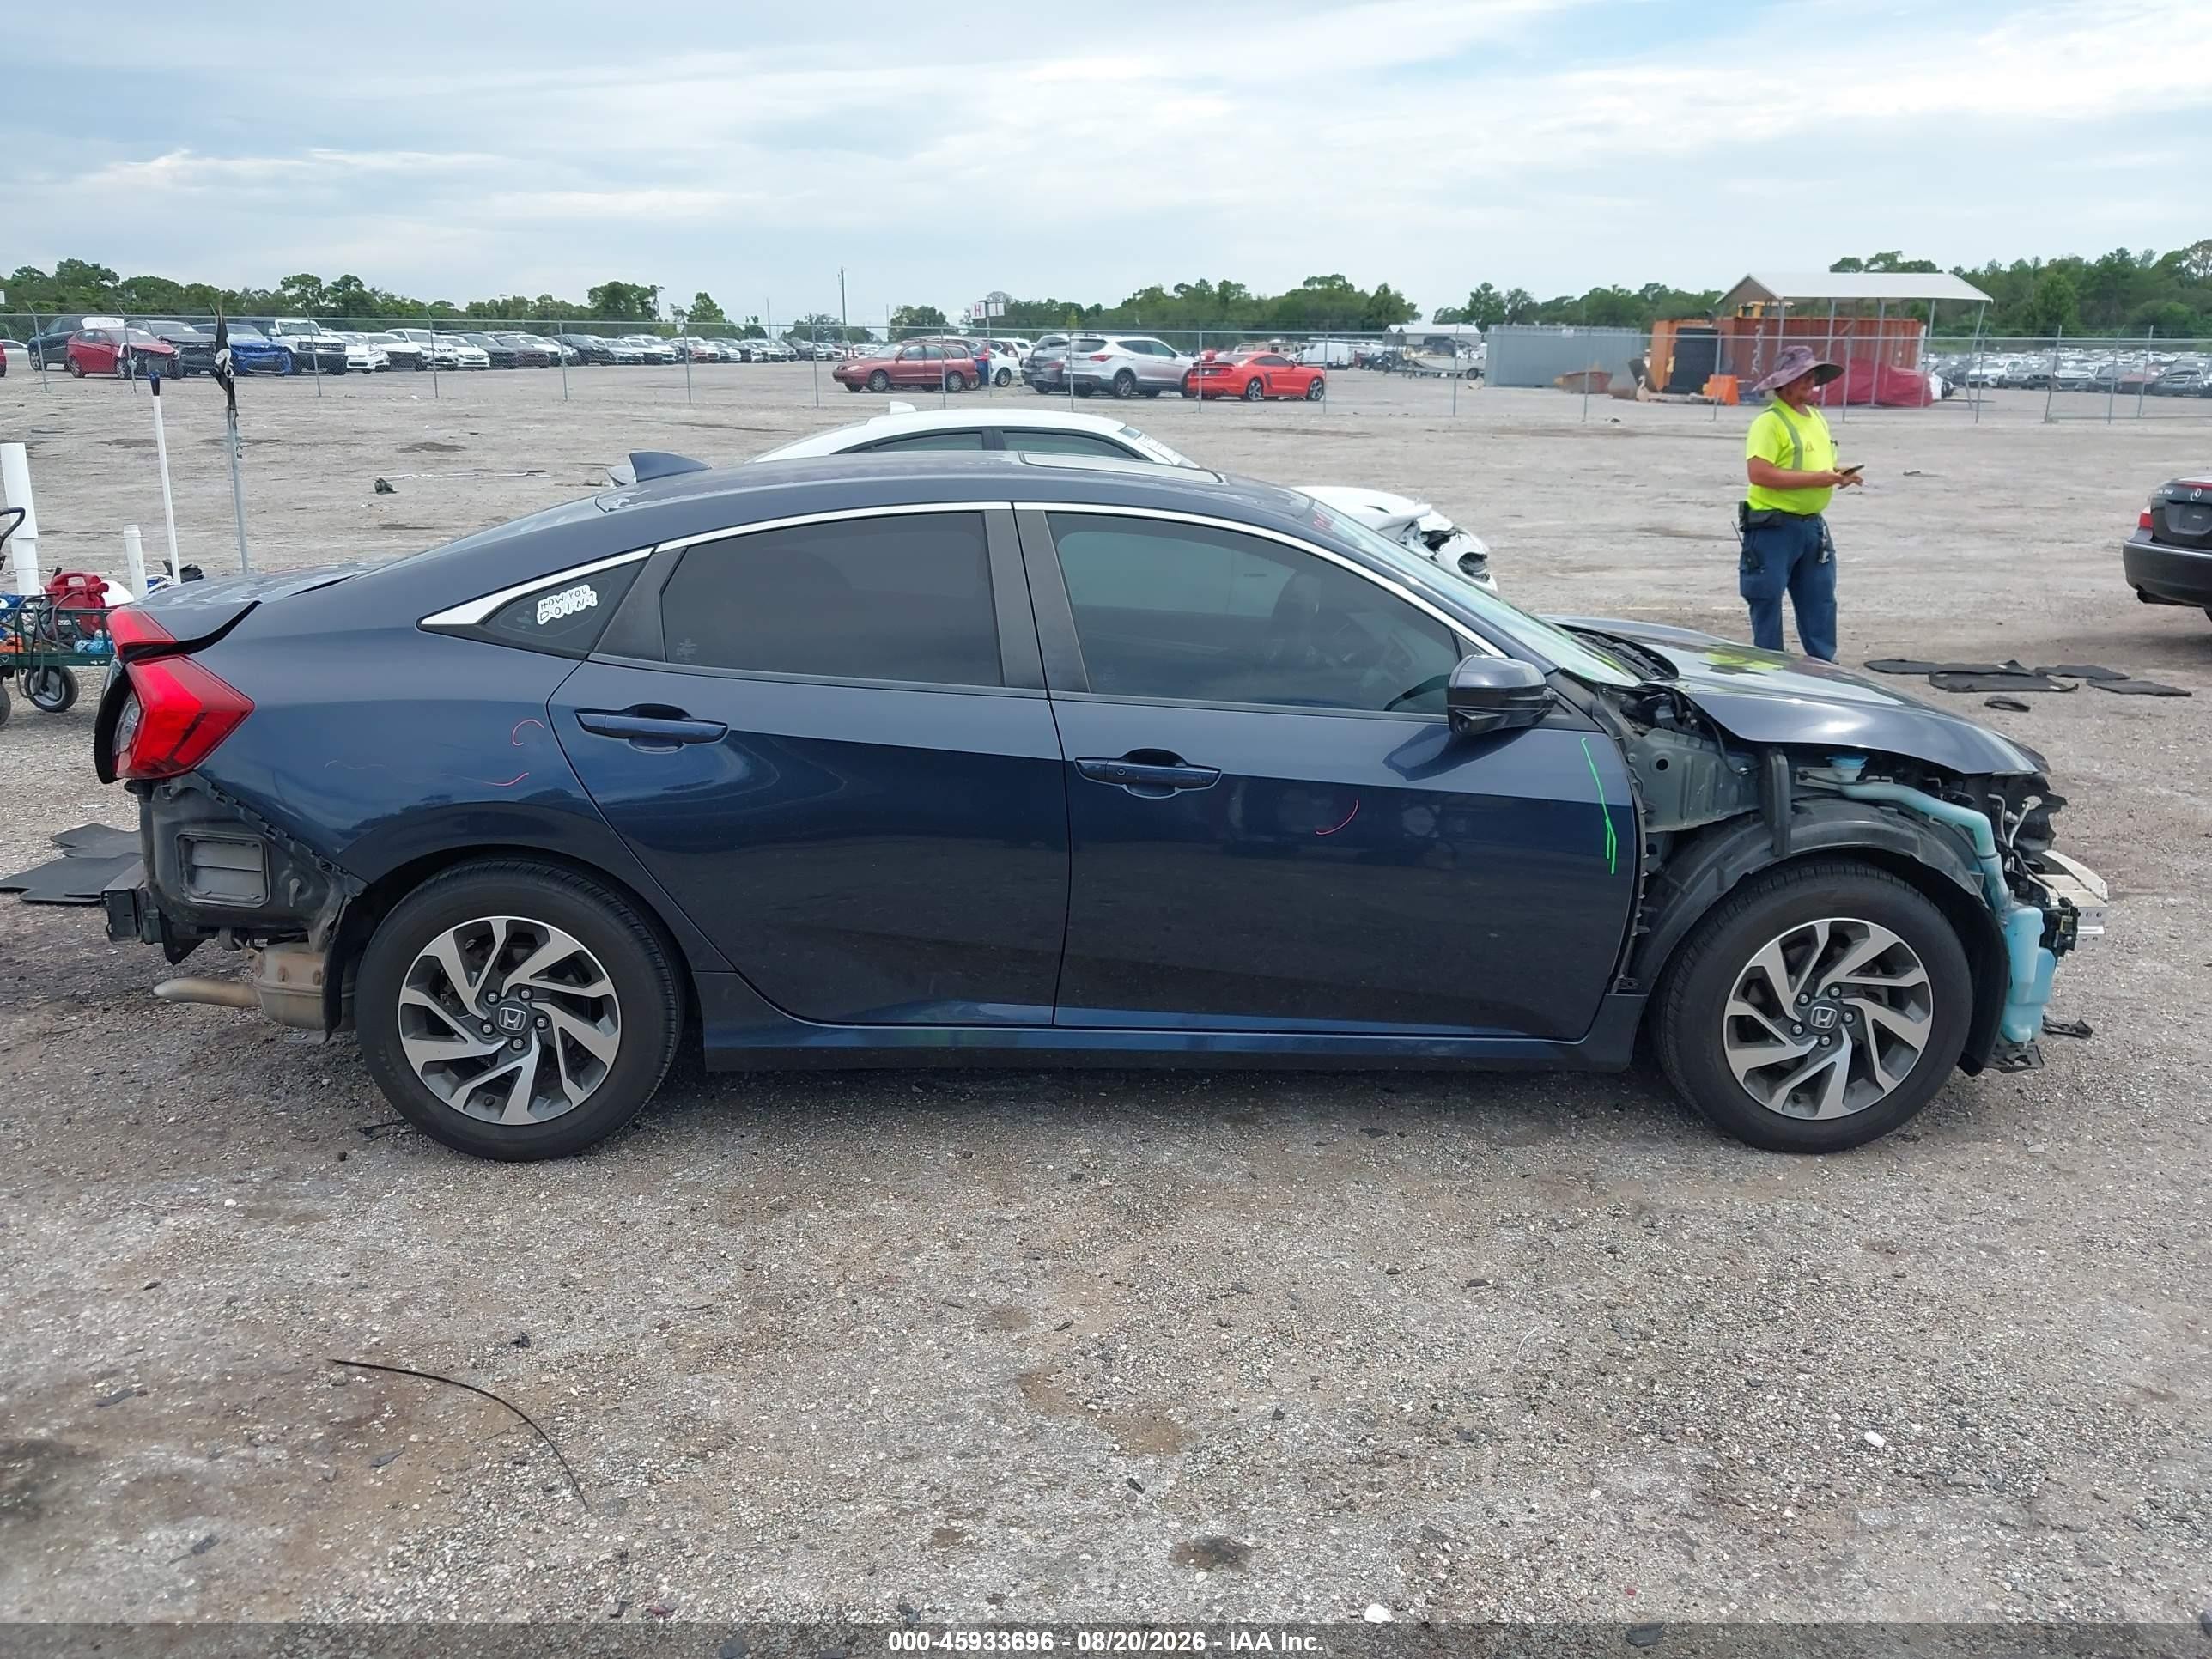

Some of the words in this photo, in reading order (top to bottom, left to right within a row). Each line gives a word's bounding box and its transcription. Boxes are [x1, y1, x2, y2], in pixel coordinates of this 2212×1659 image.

[975, 304, 981, 317] H
[541, 594, 564, 610] HOW
[568, 587, 587, 599] YOU
